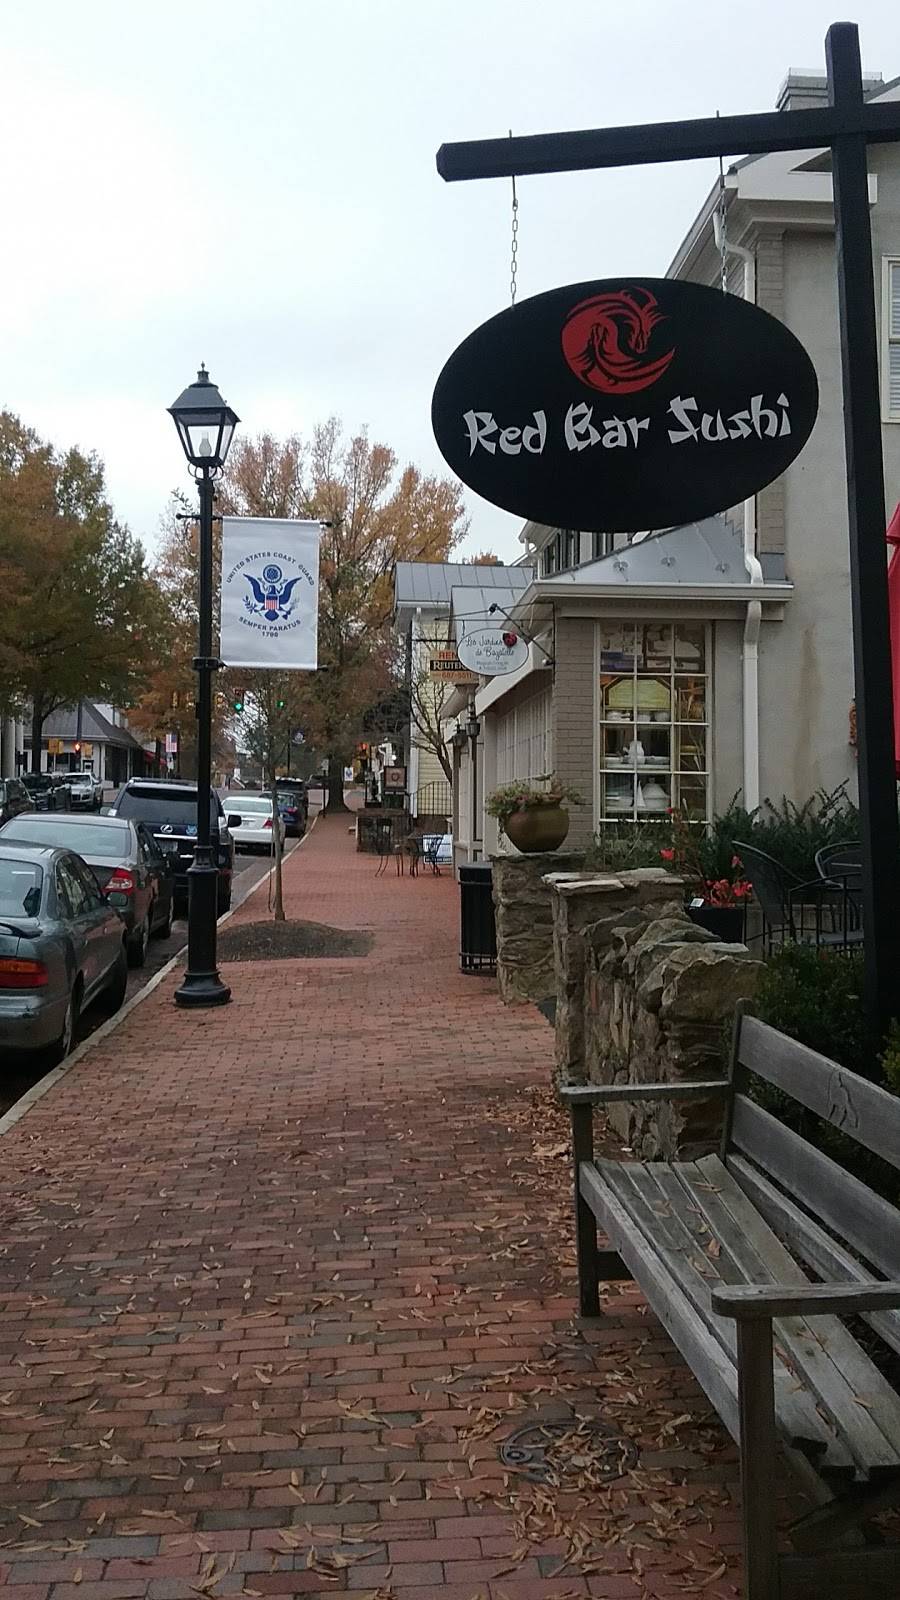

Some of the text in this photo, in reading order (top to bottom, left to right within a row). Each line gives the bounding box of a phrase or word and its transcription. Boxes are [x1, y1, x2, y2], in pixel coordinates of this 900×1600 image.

[463, 393, 792, 456] Red Bar Sushi
[227, 552, 315, 585] UNITED STATES COAST GUARD
[239, 617, 301, 631] SEMPER PARATUS
